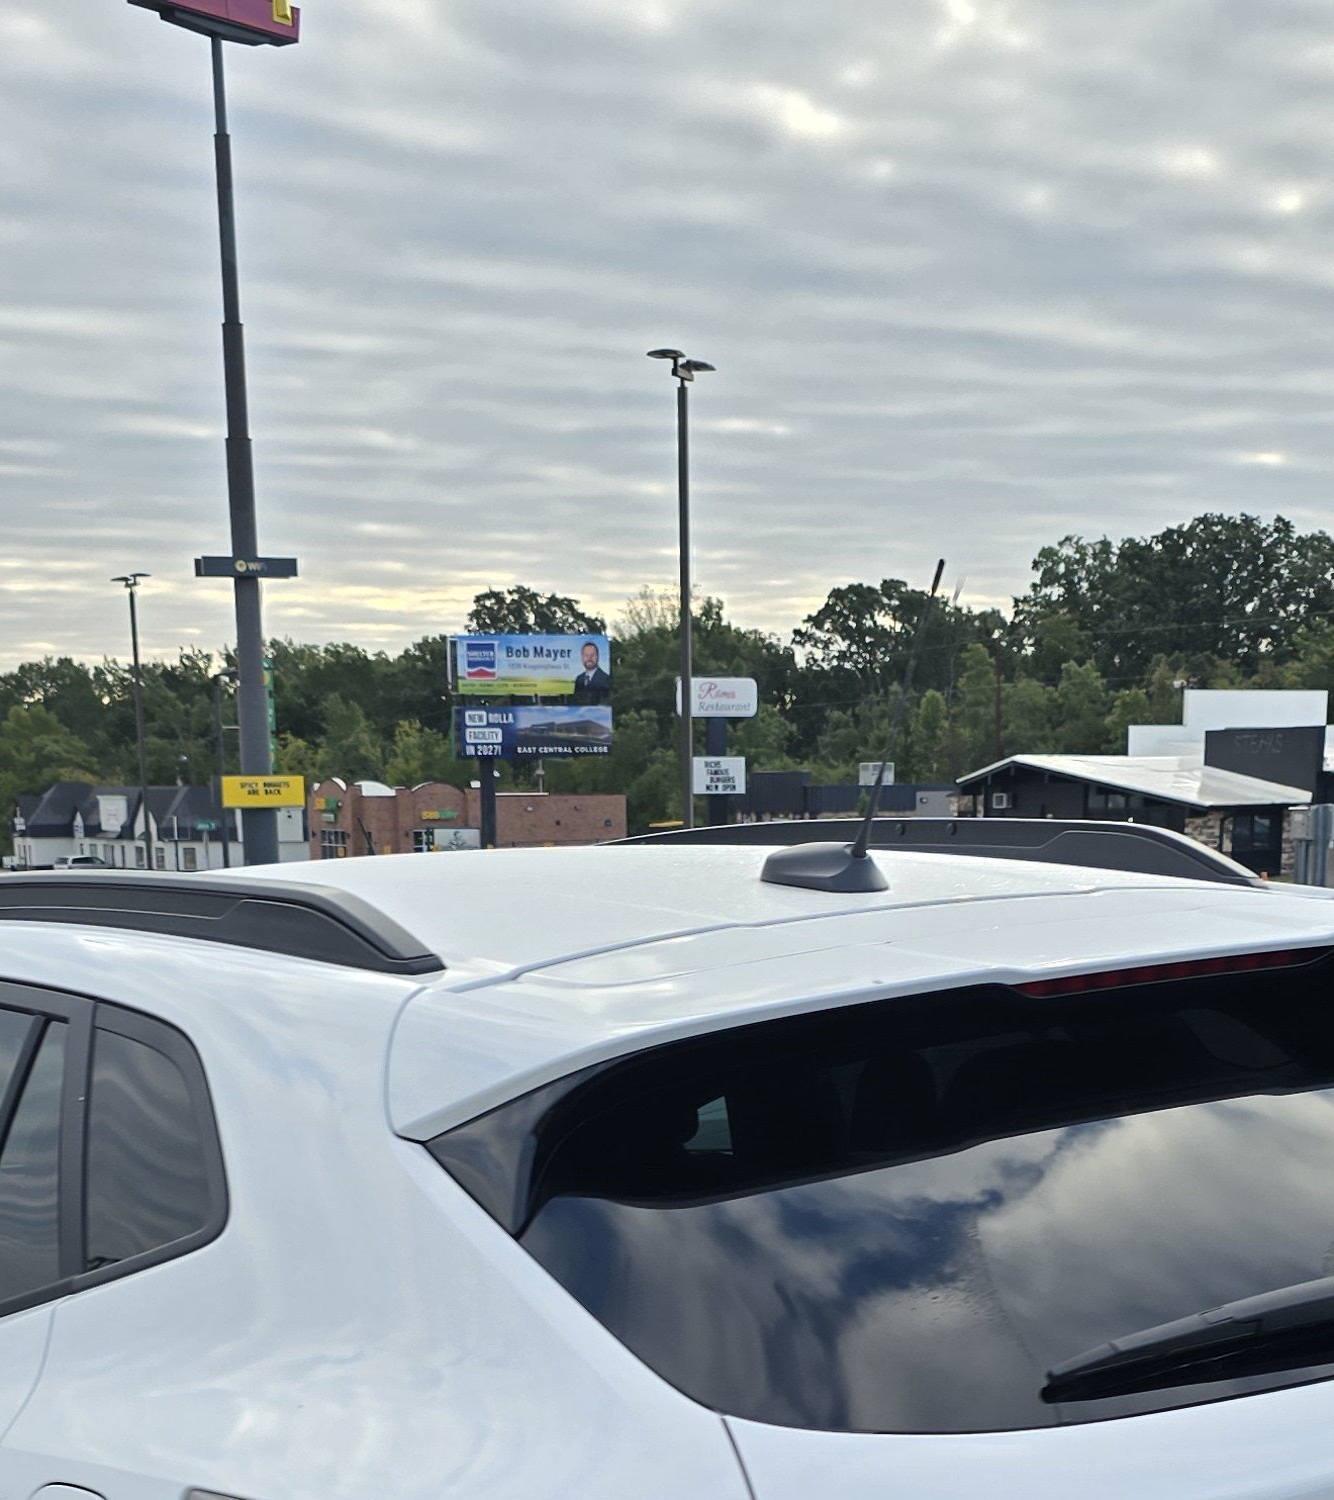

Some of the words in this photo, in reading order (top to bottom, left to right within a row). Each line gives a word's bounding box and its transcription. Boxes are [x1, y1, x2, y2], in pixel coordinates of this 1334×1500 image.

[505, 645, 530, 659] Bob
[533, 646, 573, 661] Mayer
[517, 746, 537, 754] EAST
[538, 746, 572, 754] CENTRAL
